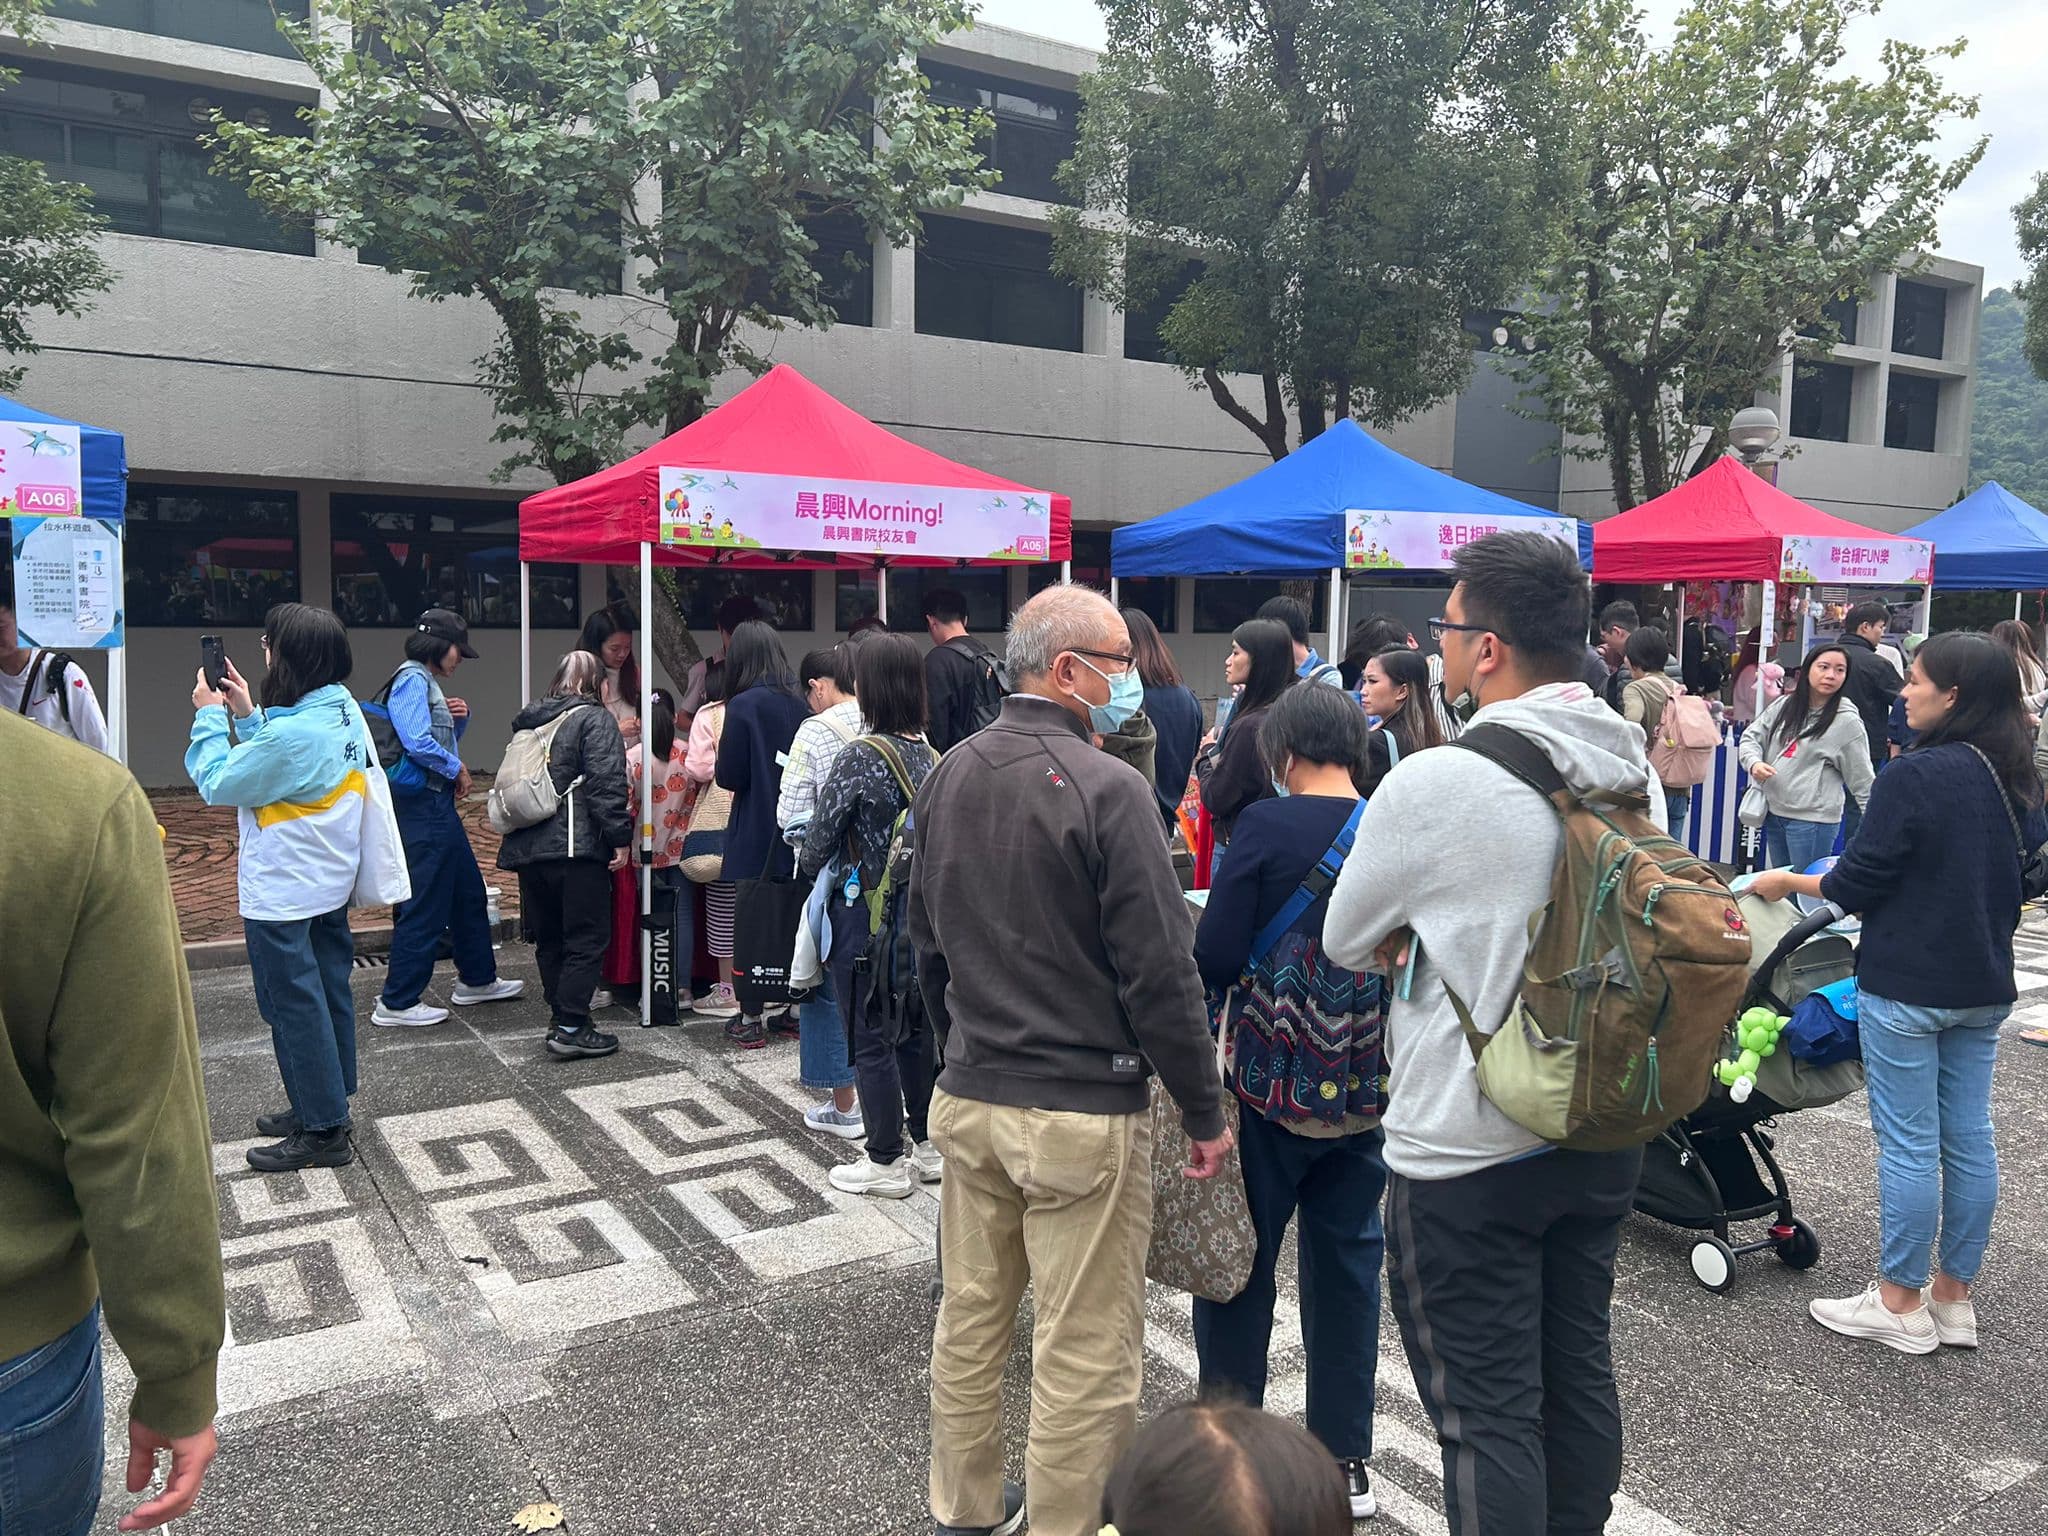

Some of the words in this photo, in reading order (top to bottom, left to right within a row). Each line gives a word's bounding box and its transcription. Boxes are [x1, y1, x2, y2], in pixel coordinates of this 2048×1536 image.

[27, 491, 66, 507] A06
[795, 491, 943, 527] 晨興Morning!
[822, 525, 917, 544] 晨興書院校友會
[1021, 540, 1041, 551] A05
[654, 929, 670, 993] MUSIC
